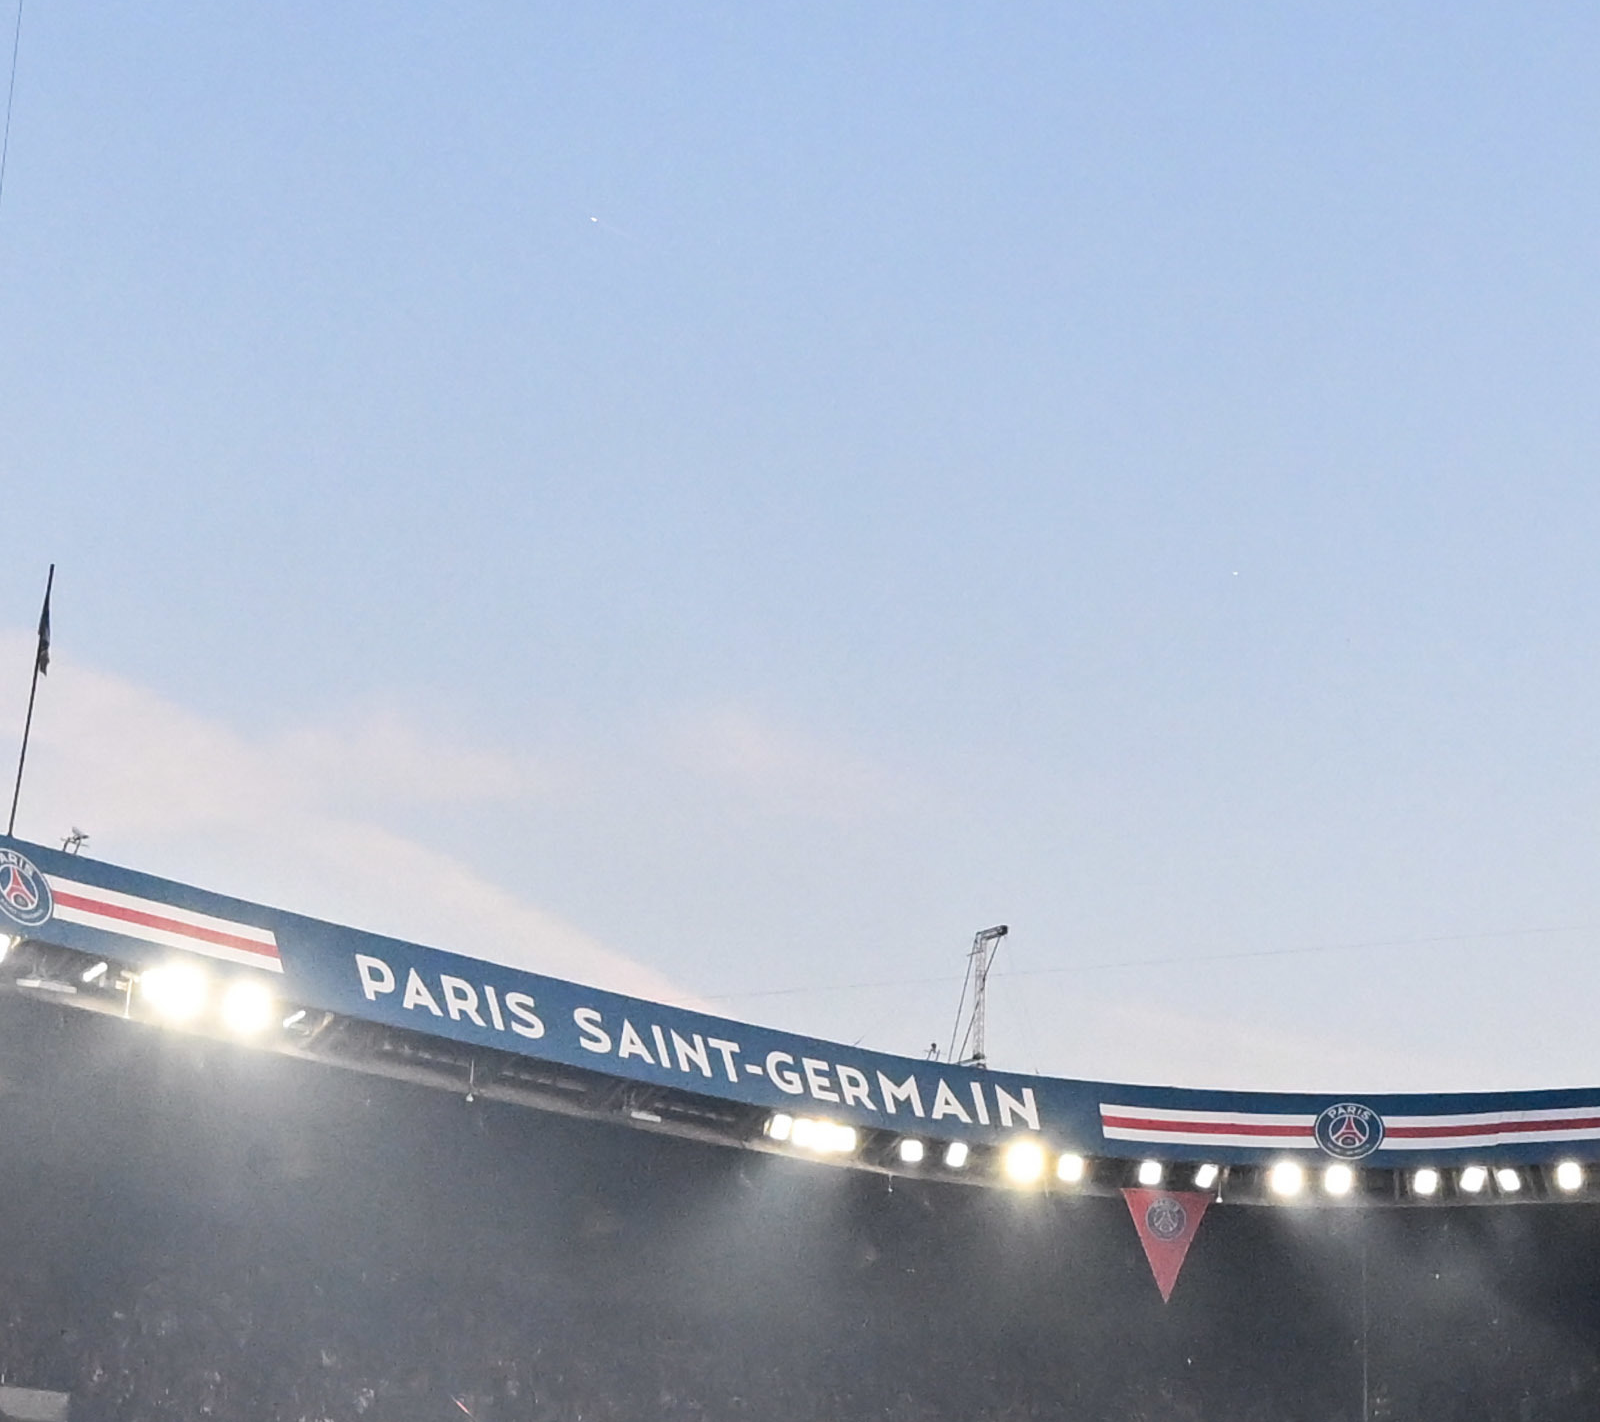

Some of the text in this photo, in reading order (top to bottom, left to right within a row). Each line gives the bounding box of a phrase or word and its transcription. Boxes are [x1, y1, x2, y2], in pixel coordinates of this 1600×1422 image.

[355, 954, 1041, 1130] PARIS SAINT-GERMAIN
[1327, 1106, 1372, 1120] PARIS
